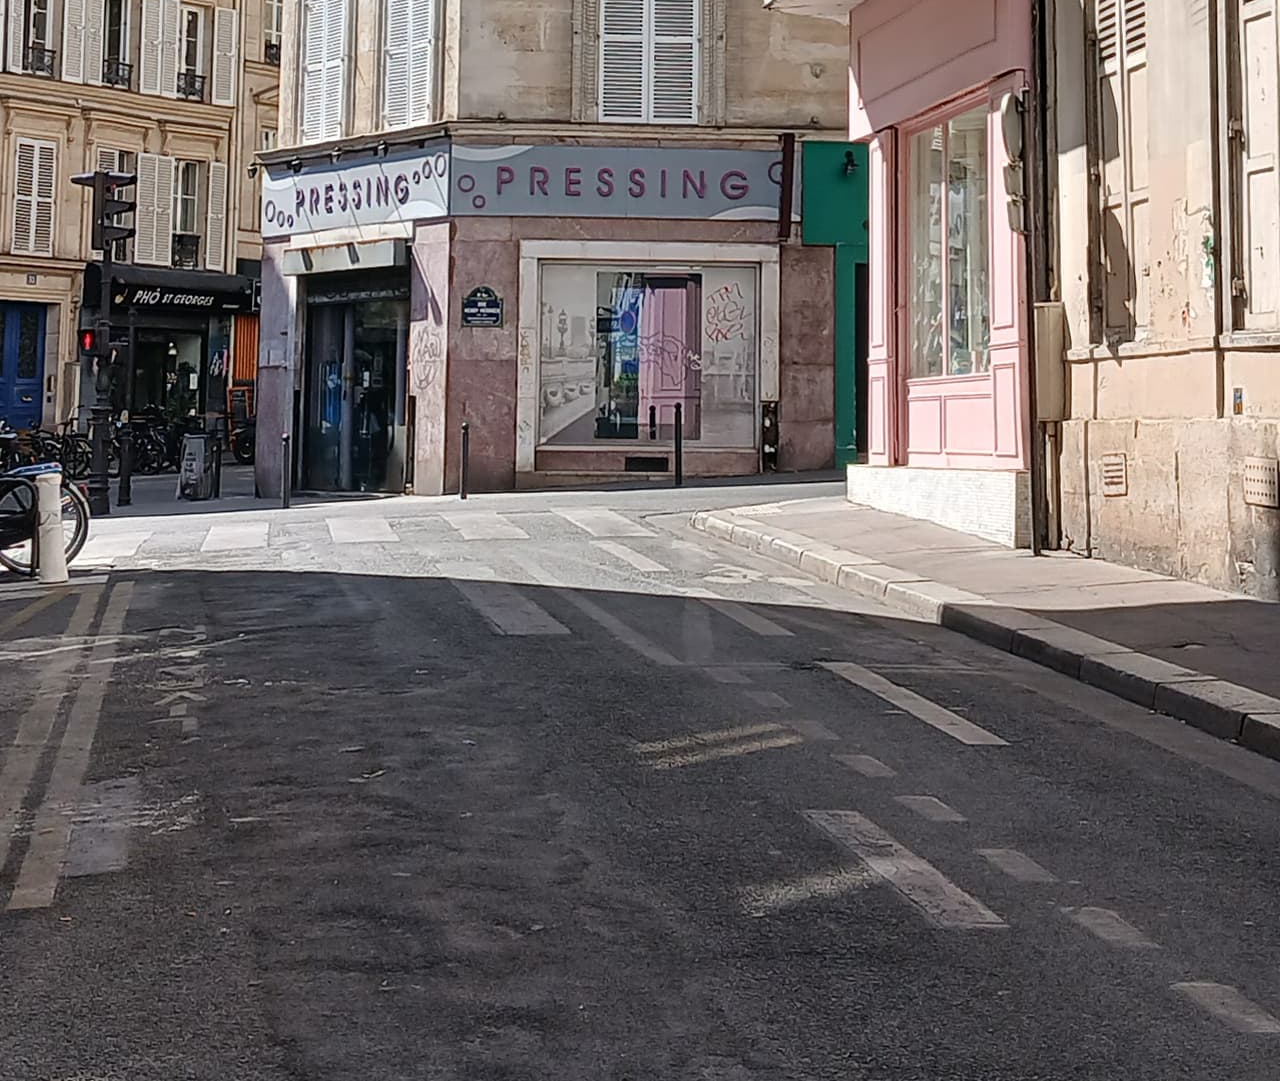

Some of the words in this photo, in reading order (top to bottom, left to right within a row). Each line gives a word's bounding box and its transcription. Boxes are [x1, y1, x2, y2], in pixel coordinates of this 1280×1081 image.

[295, 172, 410, 219] PRESSING
[496, 165, 750, 201] PRESSING
[173, 294, 215, 306] GEORGES
